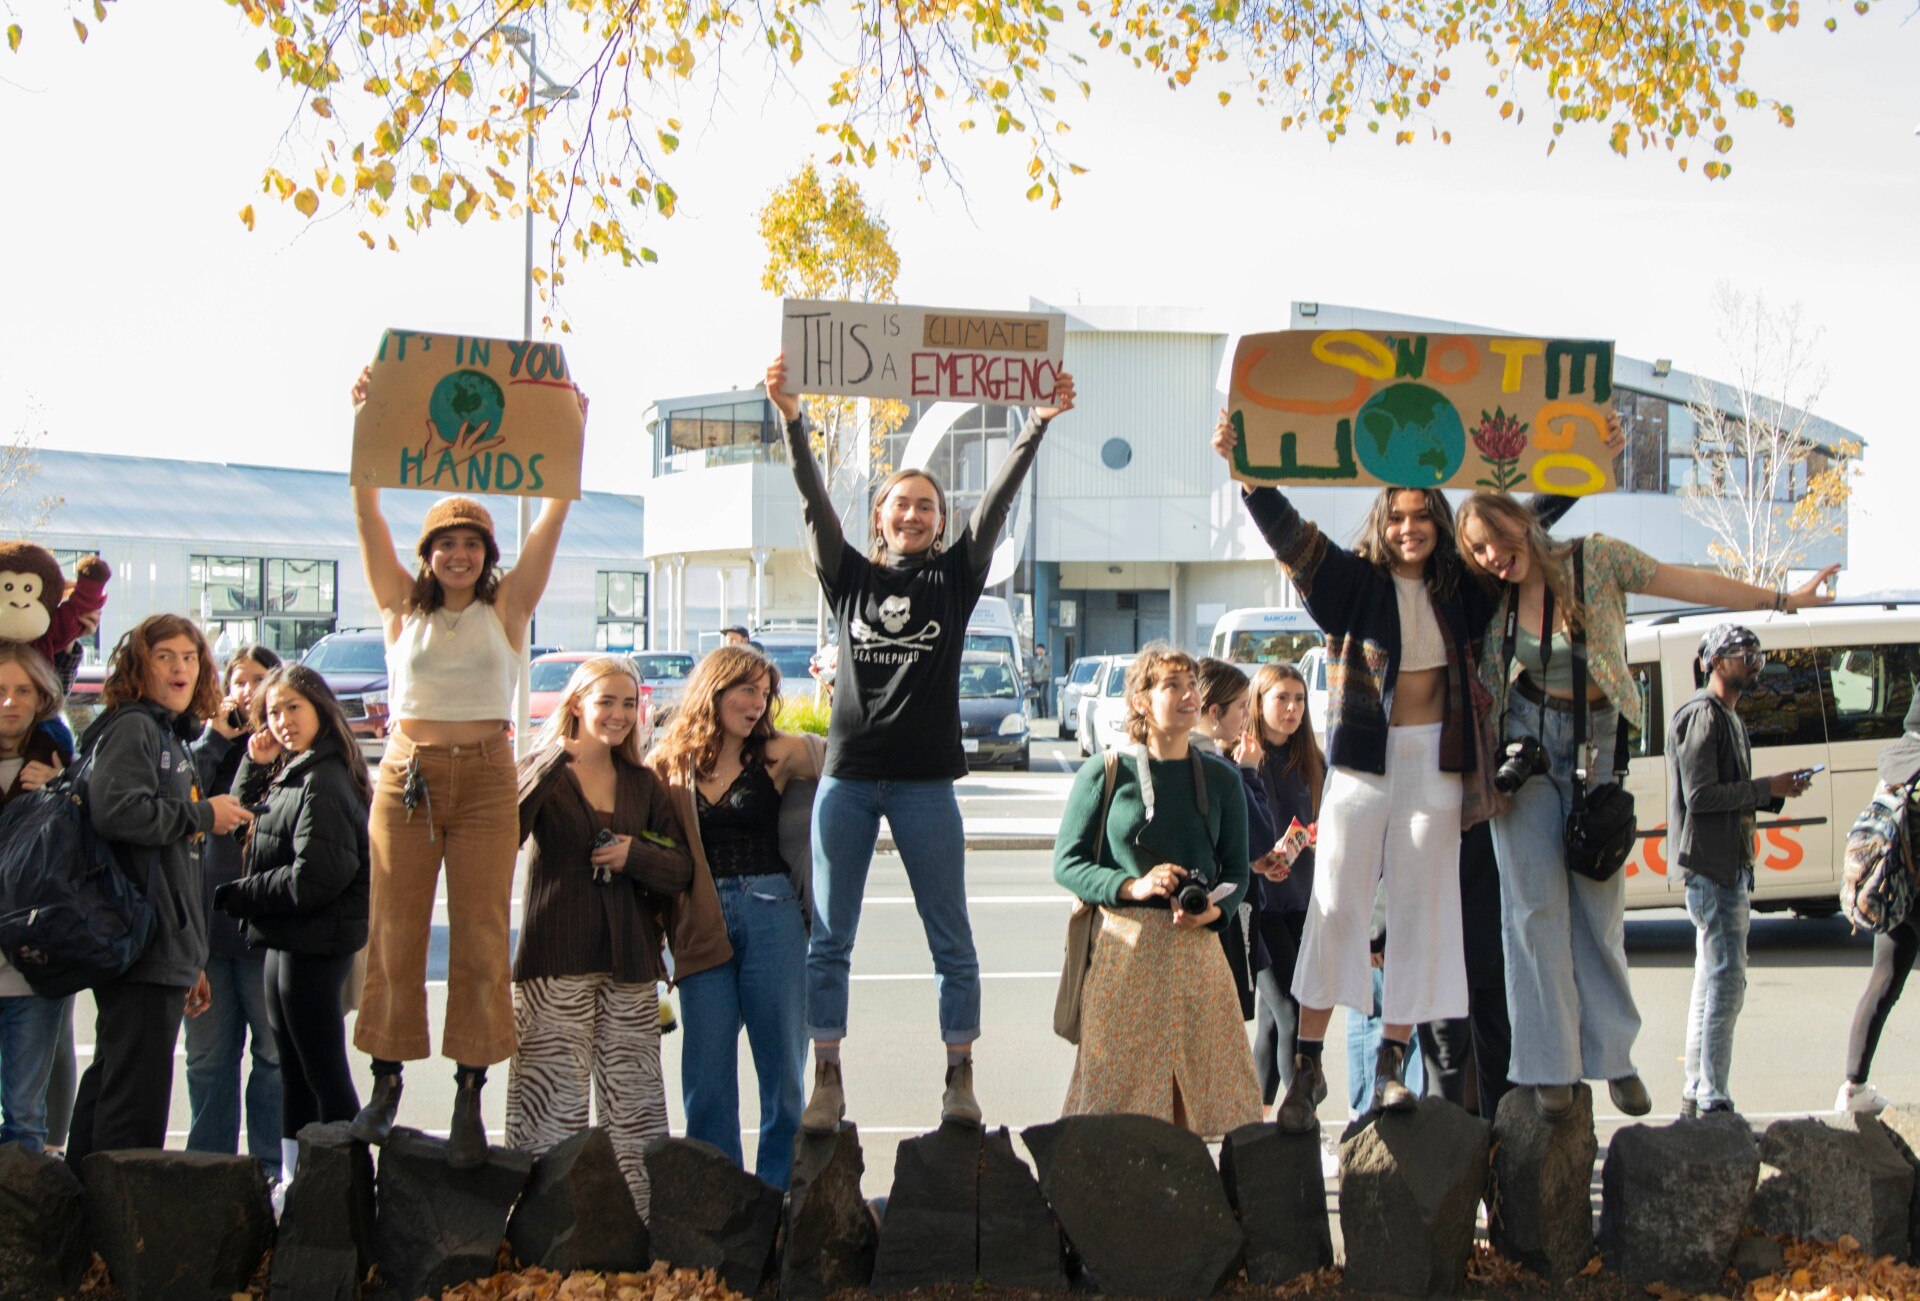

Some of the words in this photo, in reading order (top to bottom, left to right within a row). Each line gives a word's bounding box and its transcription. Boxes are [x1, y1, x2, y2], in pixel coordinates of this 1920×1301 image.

[883, 313, 901, 337] IS
[928, 315, 1043, 350] CLIMATE
[455, 335, 491, 368] IN
[785, 312, 874, 387] THIS
[881, 352, 898, 381] A
[1394, 335, 1544, 393] NOT
[911, 351, 1064, 405] EMERGENCY
[400, 447, 545, 491] HANDS
[853, 649, 871, 663] SEA
